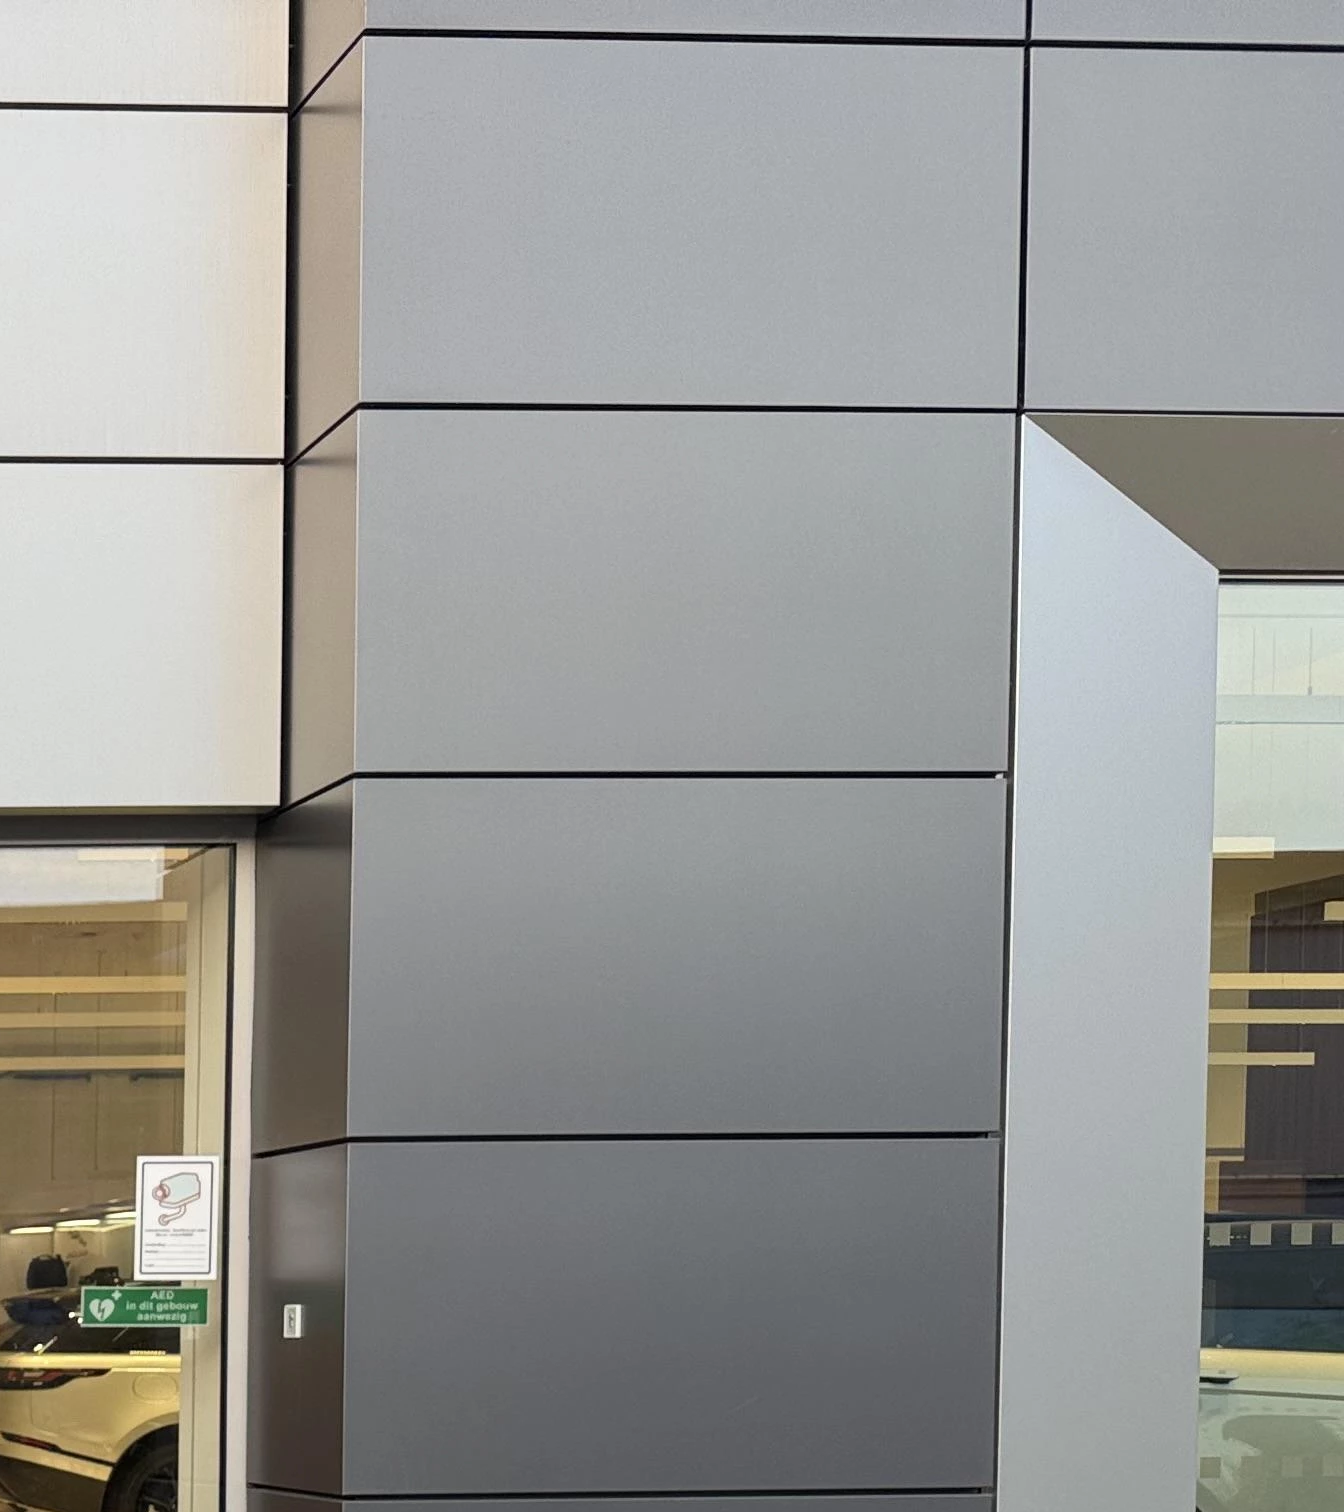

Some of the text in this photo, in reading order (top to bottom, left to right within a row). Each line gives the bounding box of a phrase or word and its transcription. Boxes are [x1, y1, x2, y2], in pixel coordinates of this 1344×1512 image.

[150, 1290, 175, 1300] AED
[125, 1301, 199, 1312] in dit gebouw
[136, 1311, 188, 1323] aanwezig
